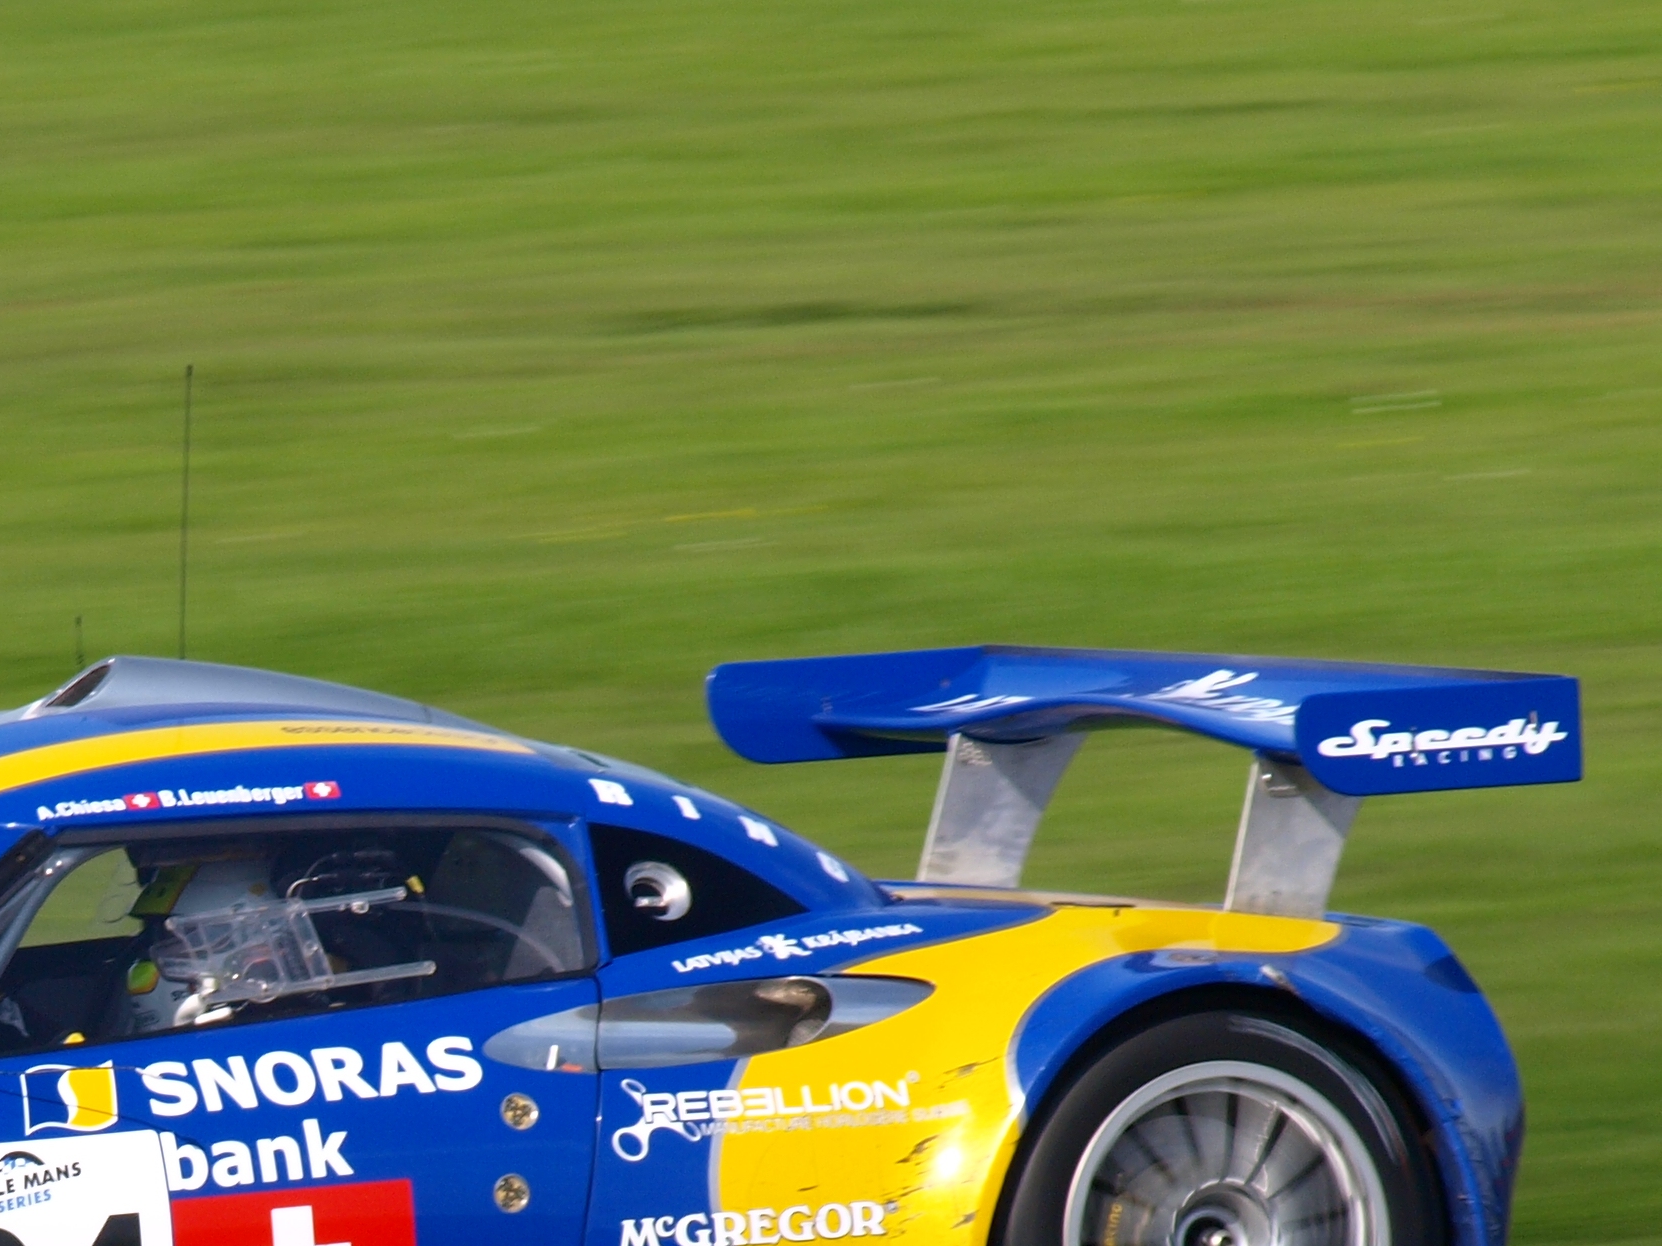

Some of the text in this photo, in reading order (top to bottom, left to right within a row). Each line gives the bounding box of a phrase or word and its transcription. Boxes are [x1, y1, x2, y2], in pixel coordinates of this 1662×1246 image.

[1317, 718, 1568, 759] Speedy
[1393, 746, 1518, 767] RACING
[142, 1035, 484, 1117] SNORAS
[160, 1117, 354, 1192] bank
[23, 1161, 82, 1190] MANS
